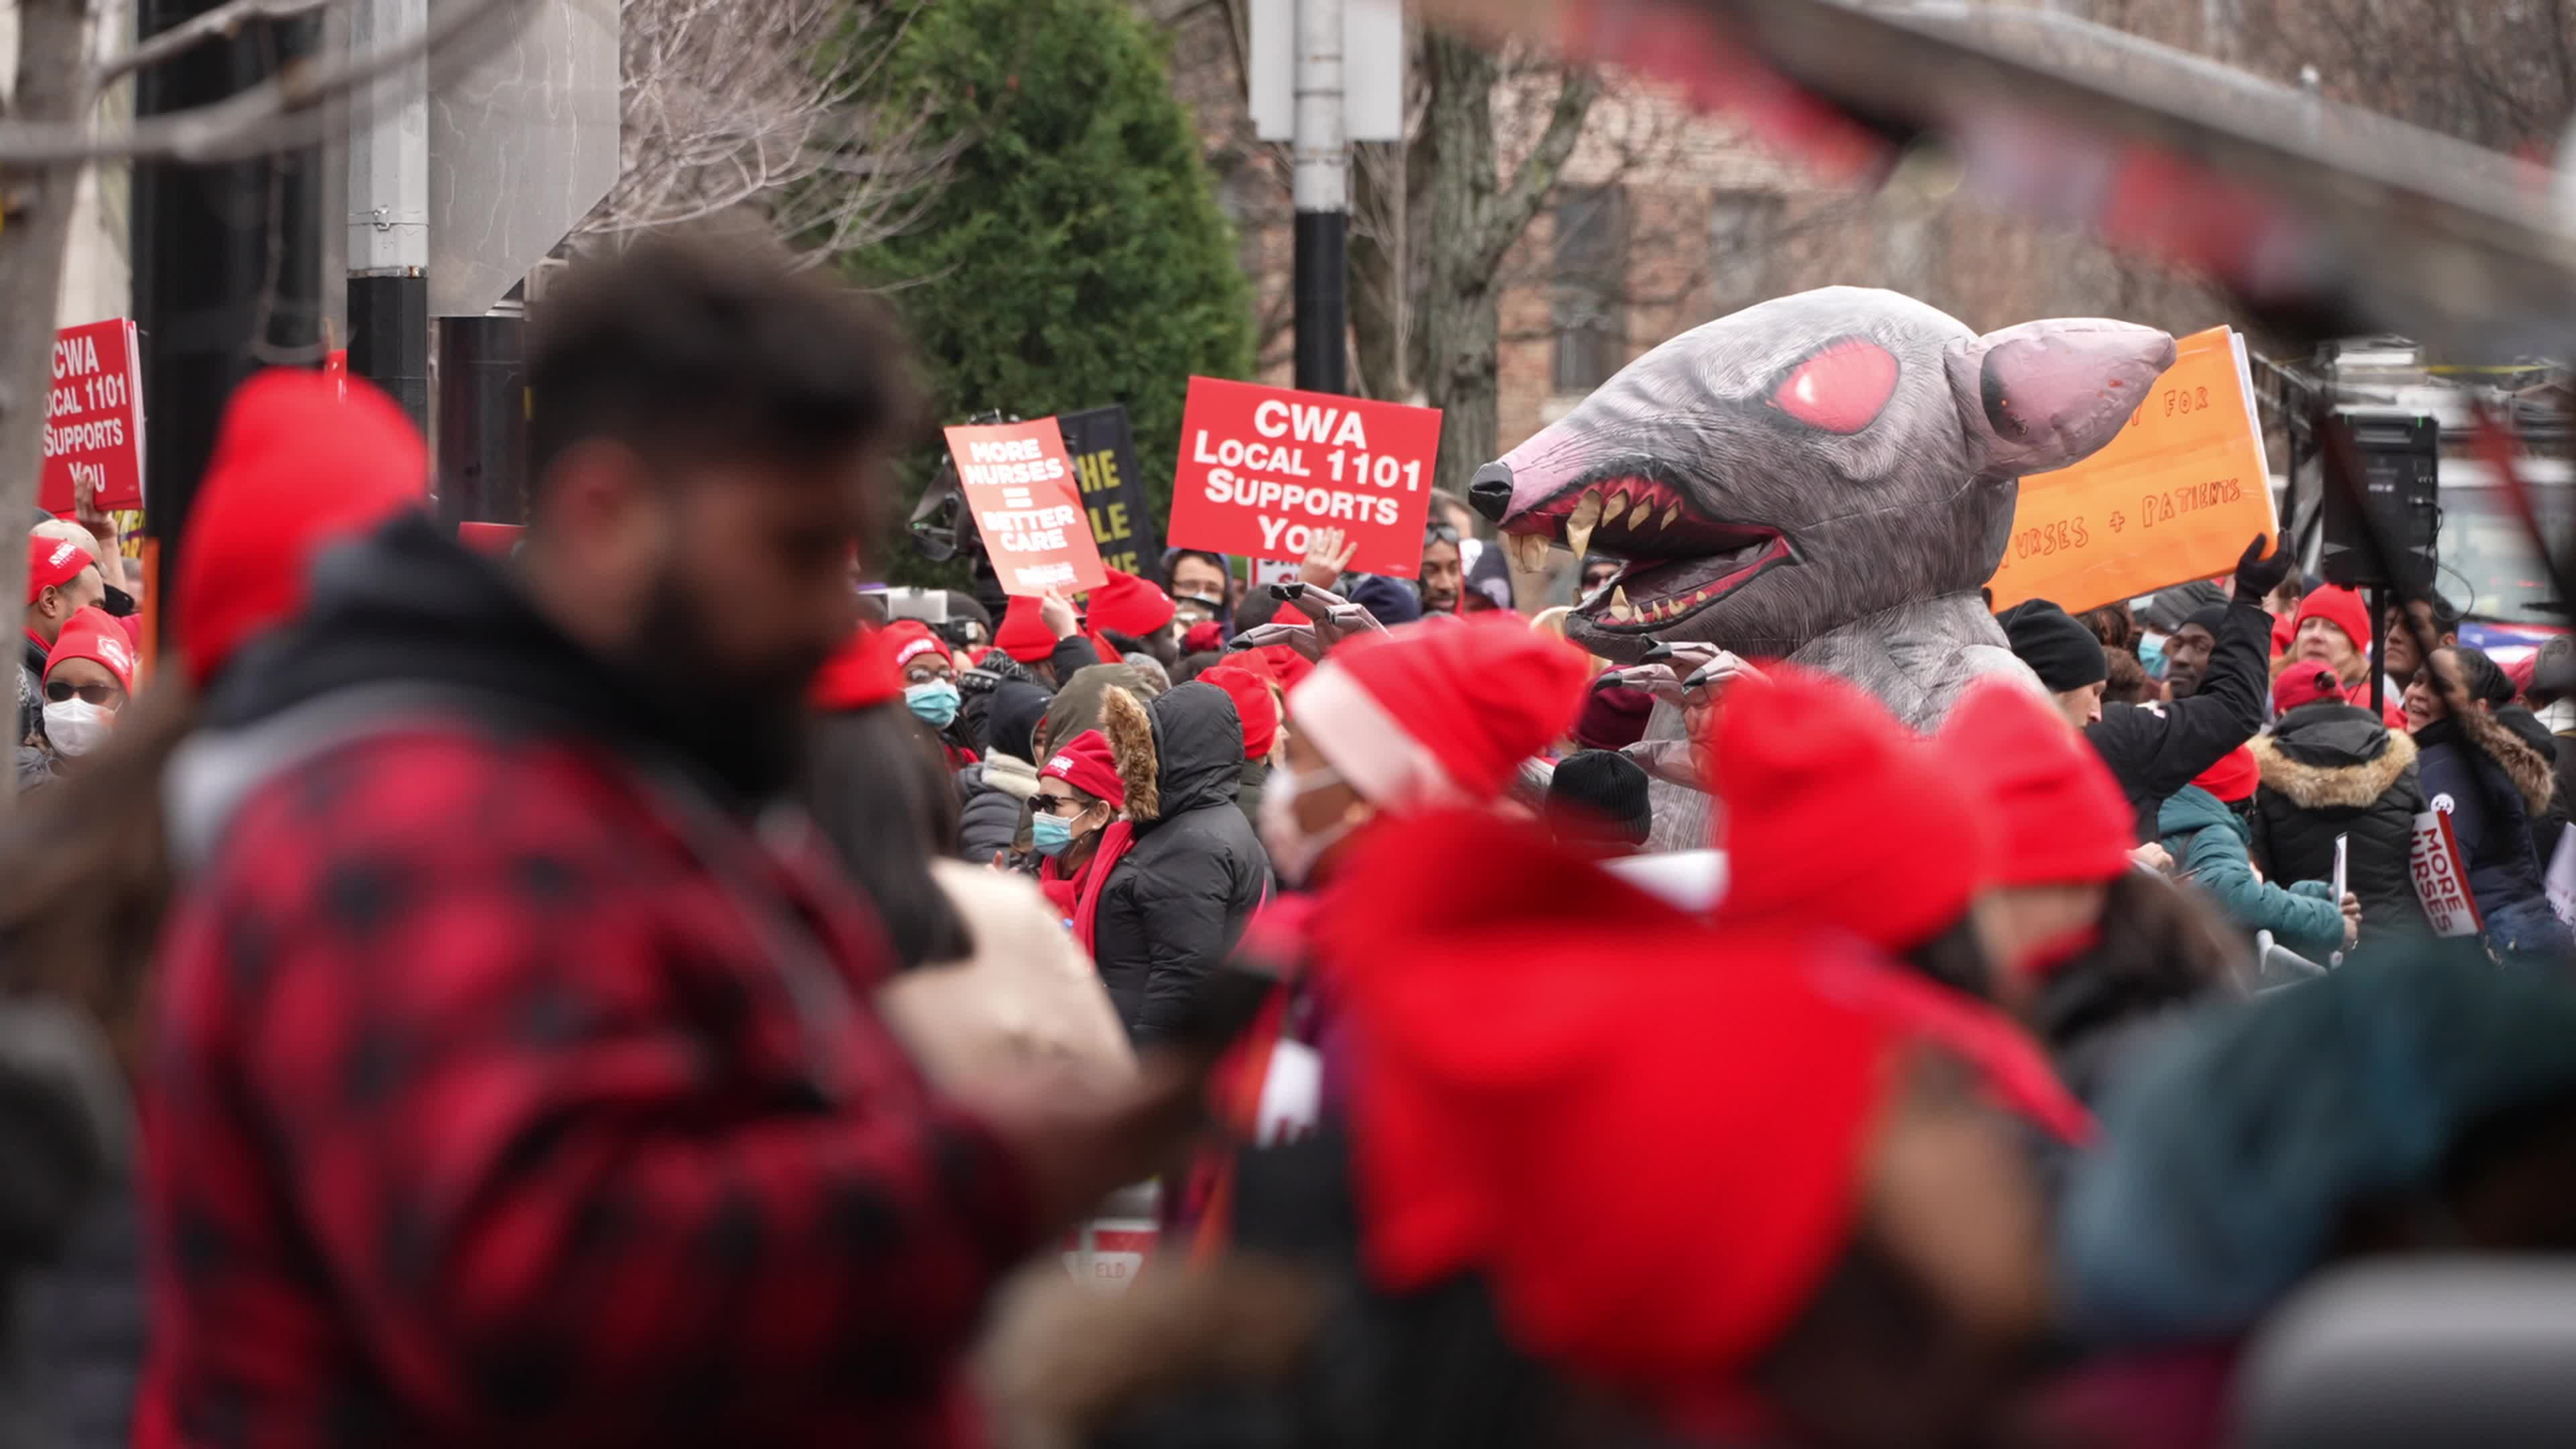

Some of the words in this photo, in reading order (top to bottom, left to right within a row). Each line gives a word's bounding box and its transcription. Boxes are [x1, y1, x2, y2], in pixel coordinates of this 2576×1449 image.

[52, 335, 100, 380] CWA
[44, 386, 83, 419] OCAL
[85, 372, 127, 411] 1101
[2163, 386, 2209, 418] FOR
[43, 417, 123, 458] SUPPORTS
[1254, 399, 1366, 449] CWA
[963, 457, 1064, 484] NURSES
[969, 437, 1042, 463] MORE
[1076, 449, 1121, 493] HE
[1193, 429, 1310, 477] LOCAL
[1326, 449, 1421, 491] 1101
[981, 504, 1076, 532] BETTER
[1204, 468, 1399, 526] SUPPORTS
[2141, 478, 2241, 529] PATIENTS
[1000, 527, 1068, 551] CARE
[2423, 828, 2463, 912] MORE
